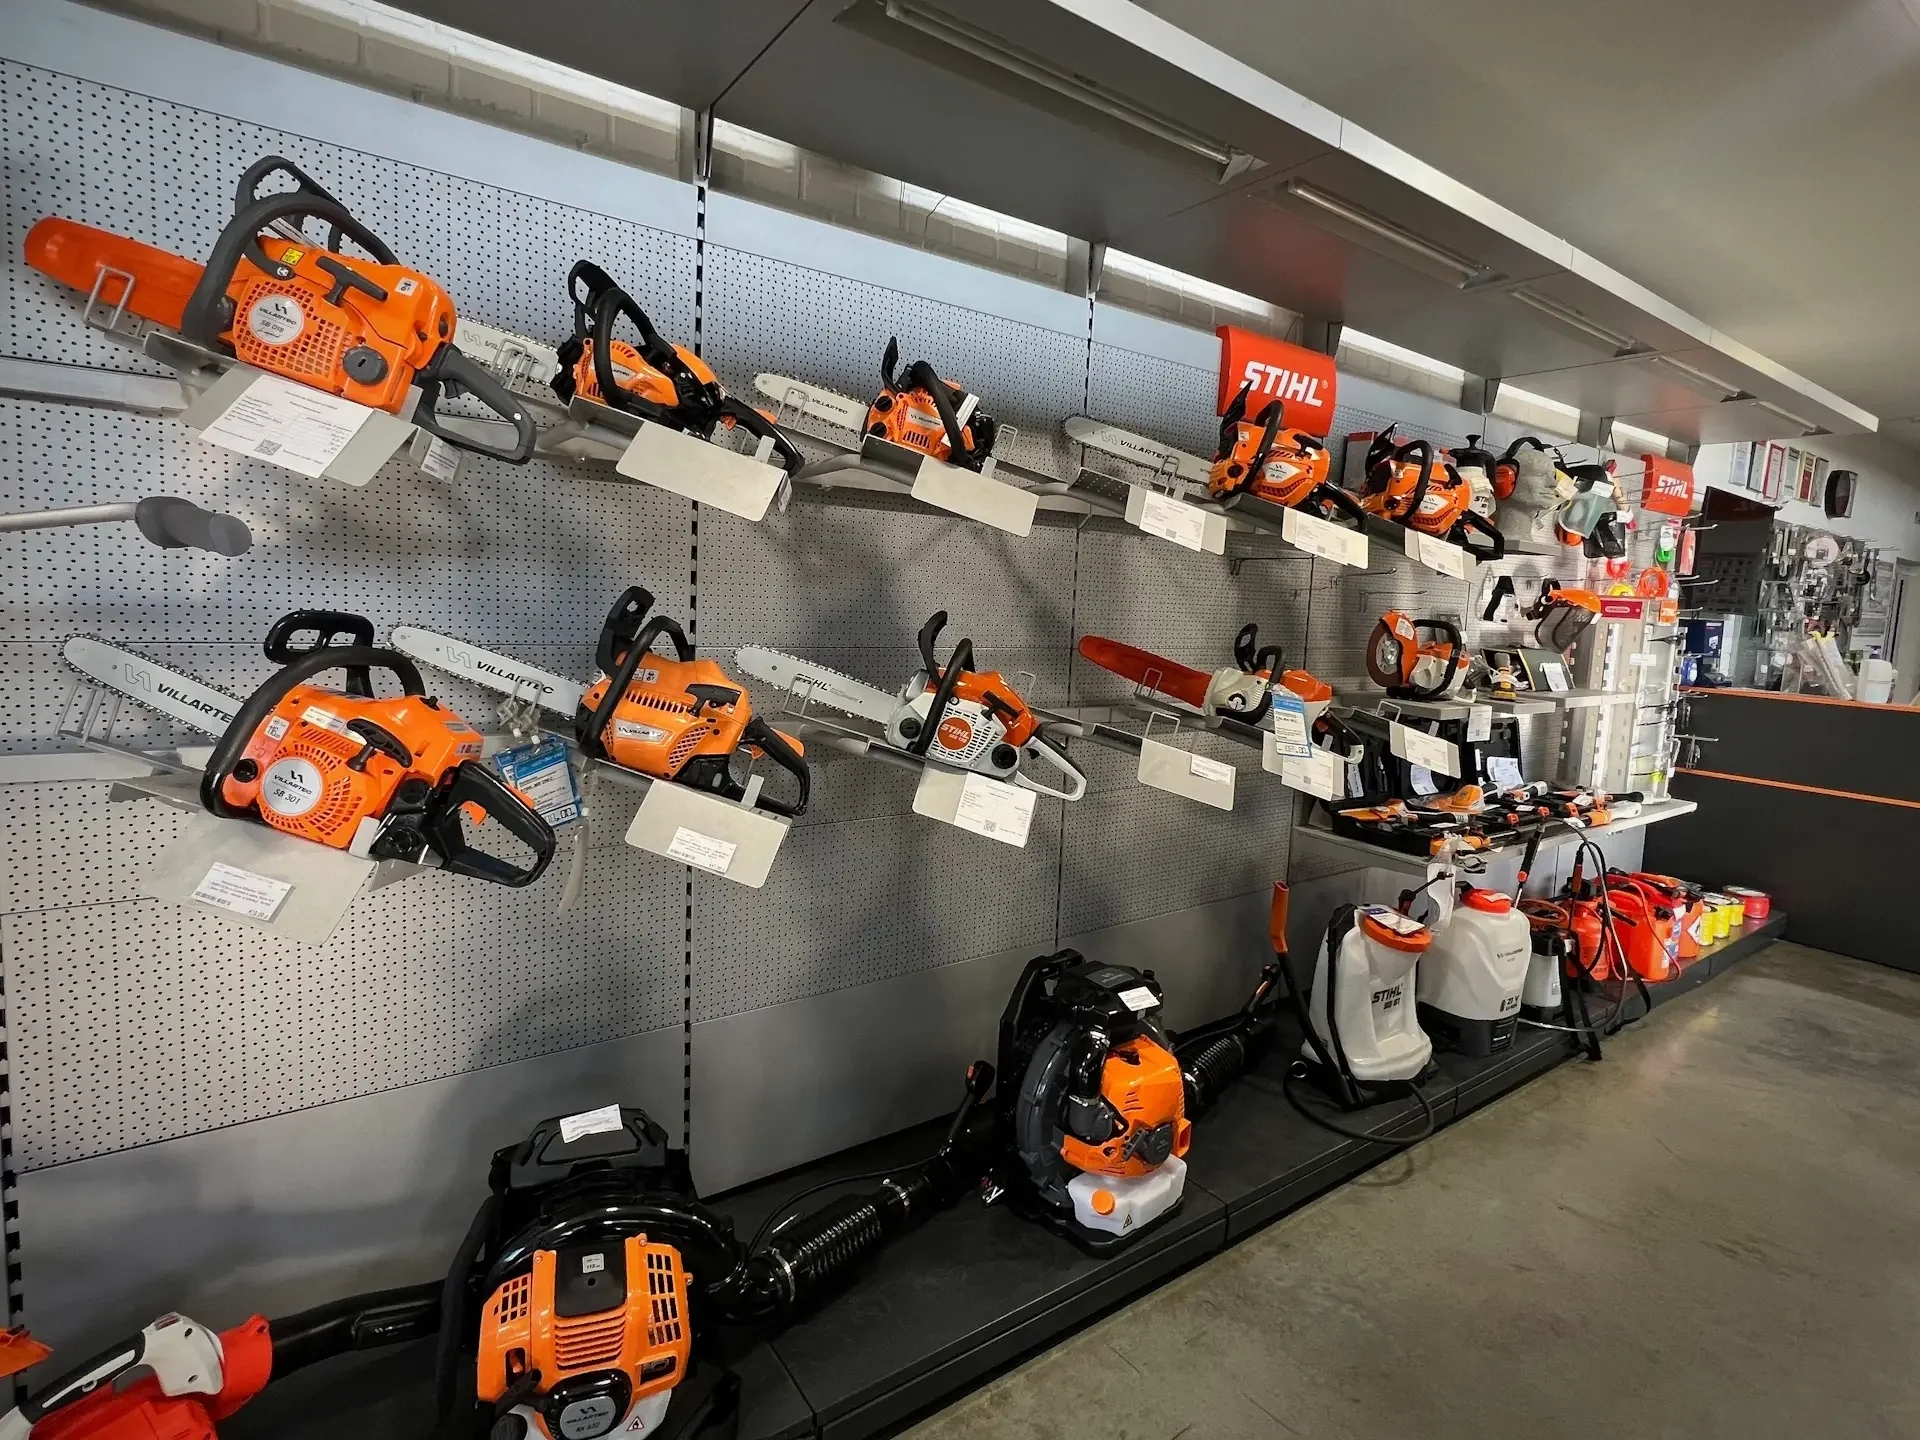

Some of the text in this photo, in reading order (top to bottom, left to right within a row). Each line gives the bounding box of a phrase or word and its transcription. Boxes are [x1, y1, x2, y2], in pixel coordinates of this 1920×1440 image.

[1239, 361, 1323, 408] STIHL
[812, 397, 848, 415] VILLARTEC
[1655, 474, 1689, 499] STIHL
[157, 683, 235, 724] VILLARTE
[941, 723, 970, 740] STIHL
[274, 774, 313, 795] VILLARTEC
[273, 788, 301, 805] SB 301
[1372, 985, 1401, 1004] STIHL
